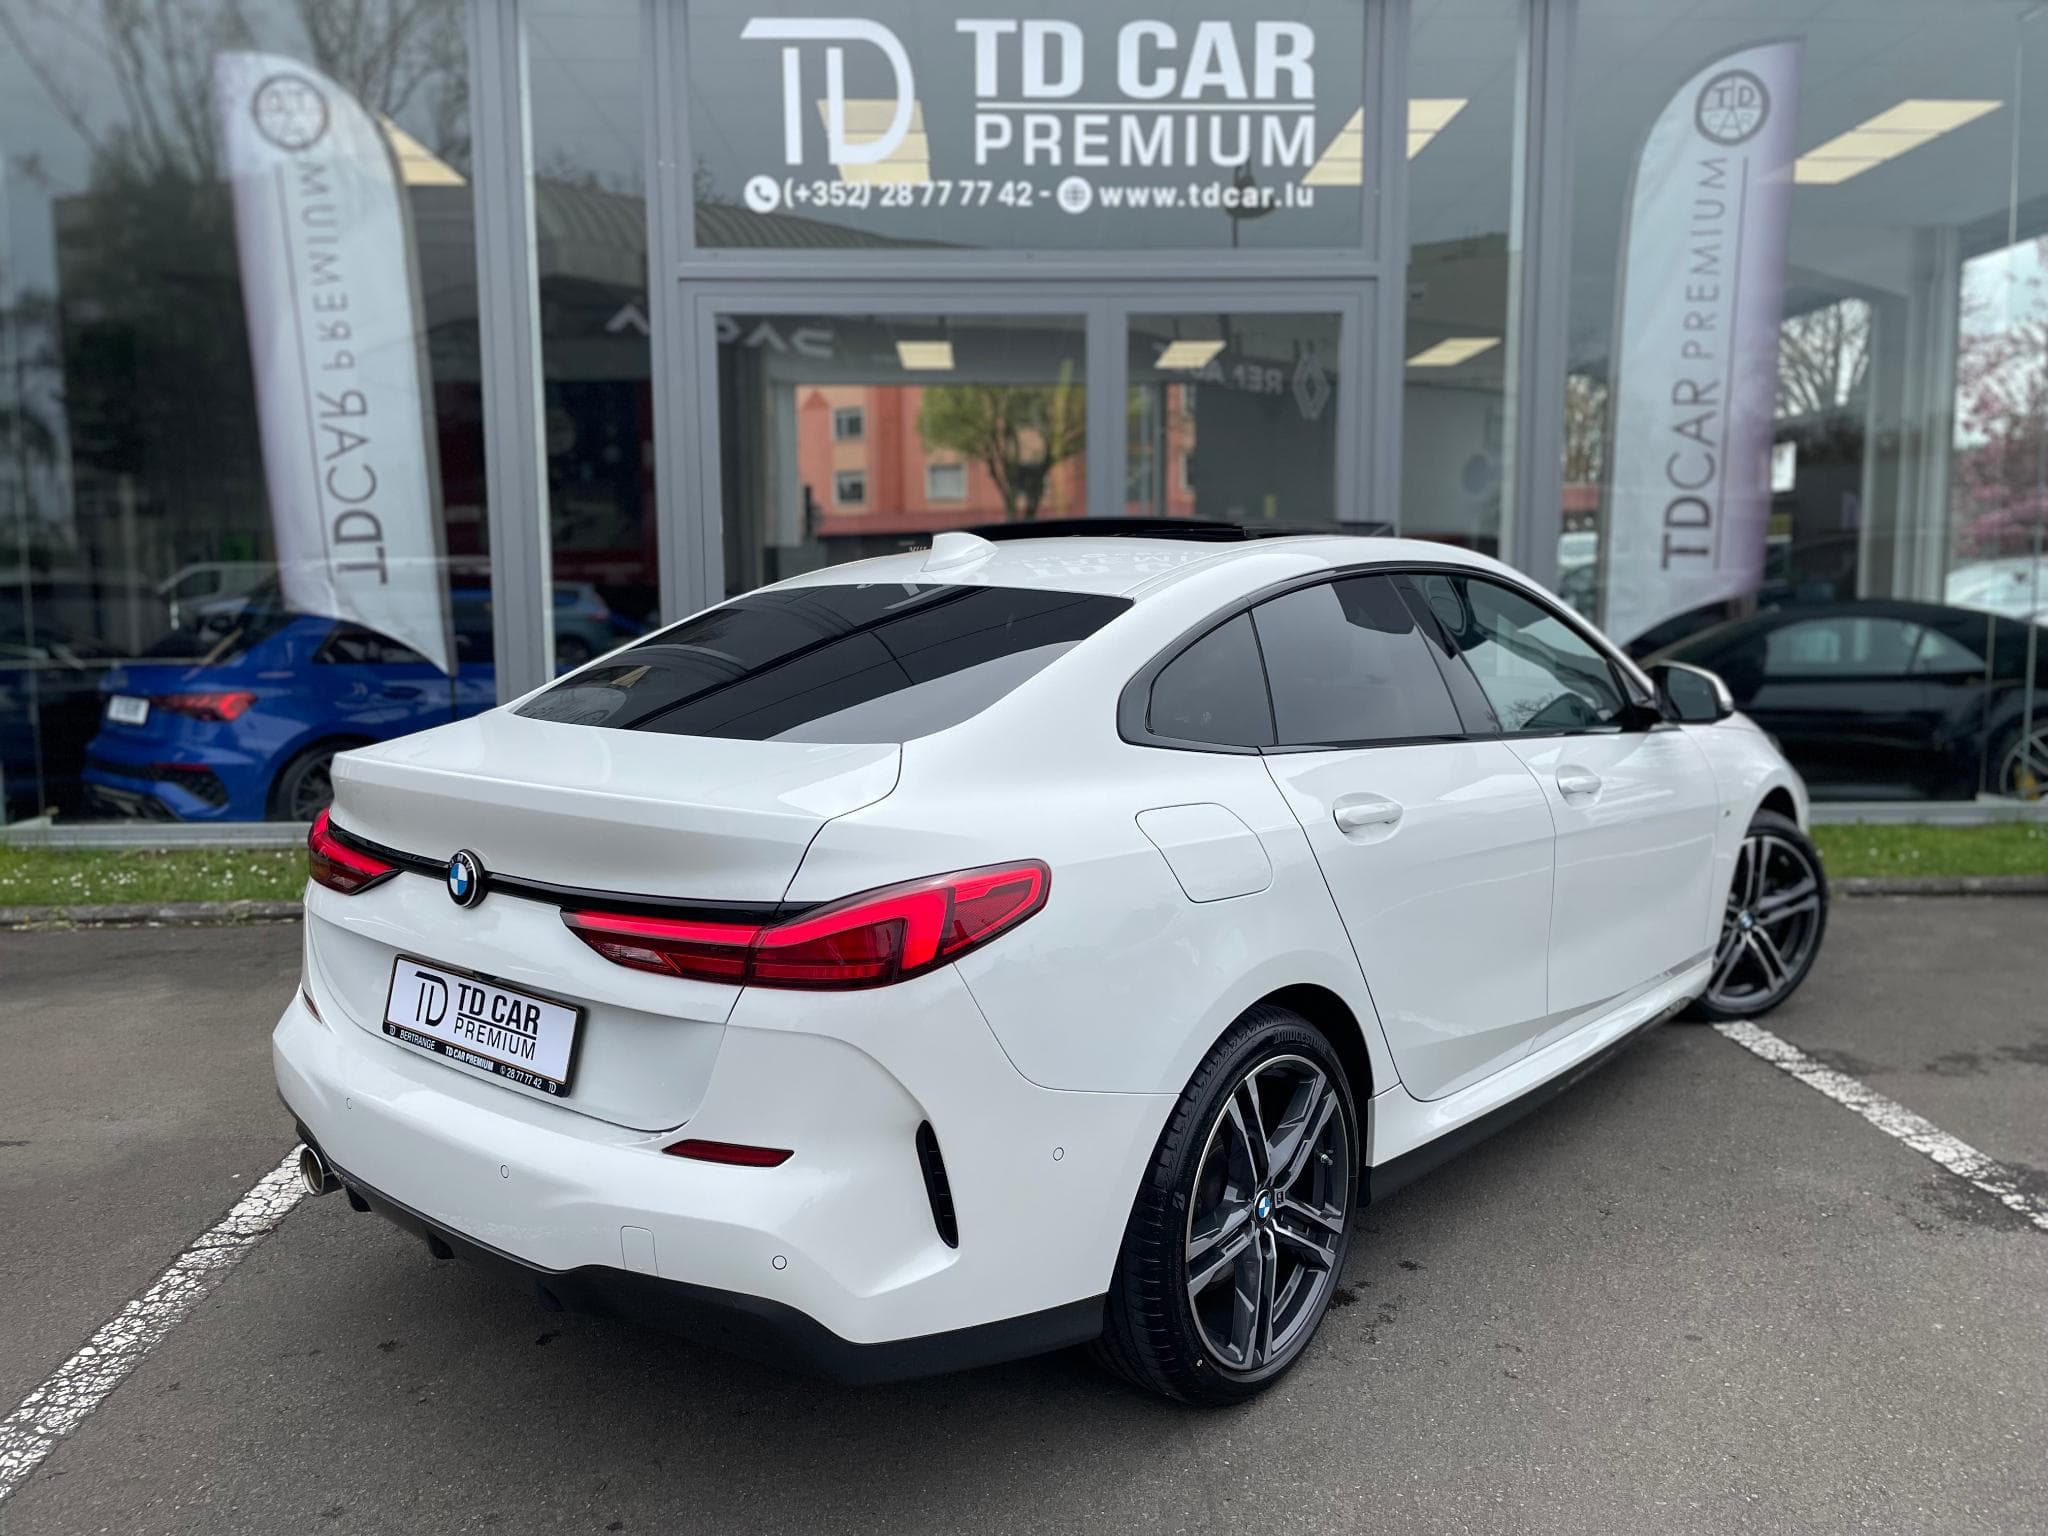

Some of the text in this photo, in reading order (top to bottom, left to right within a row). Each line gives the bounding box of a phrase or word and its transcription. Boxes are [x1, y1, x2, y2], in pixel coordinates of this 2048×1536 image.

[955, 20, 1316, 98] TD CAR
[974, 114, 1316, 166] PREMIUM
[783, 178, 871, 209] (+352)
[880, 181, 914, 206] 28
[920, 181, 953, 206] 77
[958, 181, 993, 206] 77
[998, 181, 1033, 206] 42
[1099, 181, 1316, 208] www.tdcar.lu
[1659, 157, 1727, 571] TDCAR PREMIUM
[457, 982, 541, 1036] TD CAR
[399, 1029, 436, 1050] BERTRANGE
[445, 1046, 453, 1057] TD
[453, 1049, 466, 1062] CAR
[465, 1053, 494, 1071] PREMIUM
[506, 1067, 515, 1079] 28
[515, 1069, 524, 1082] 77
[524, 1072, 533, 1085] 77
[533, 1077, 542, 1089] 42
[453, 1017, 537, 1061] PREMIUM
[1272, 1028, 1330, 1057] BRIDGESTONE
